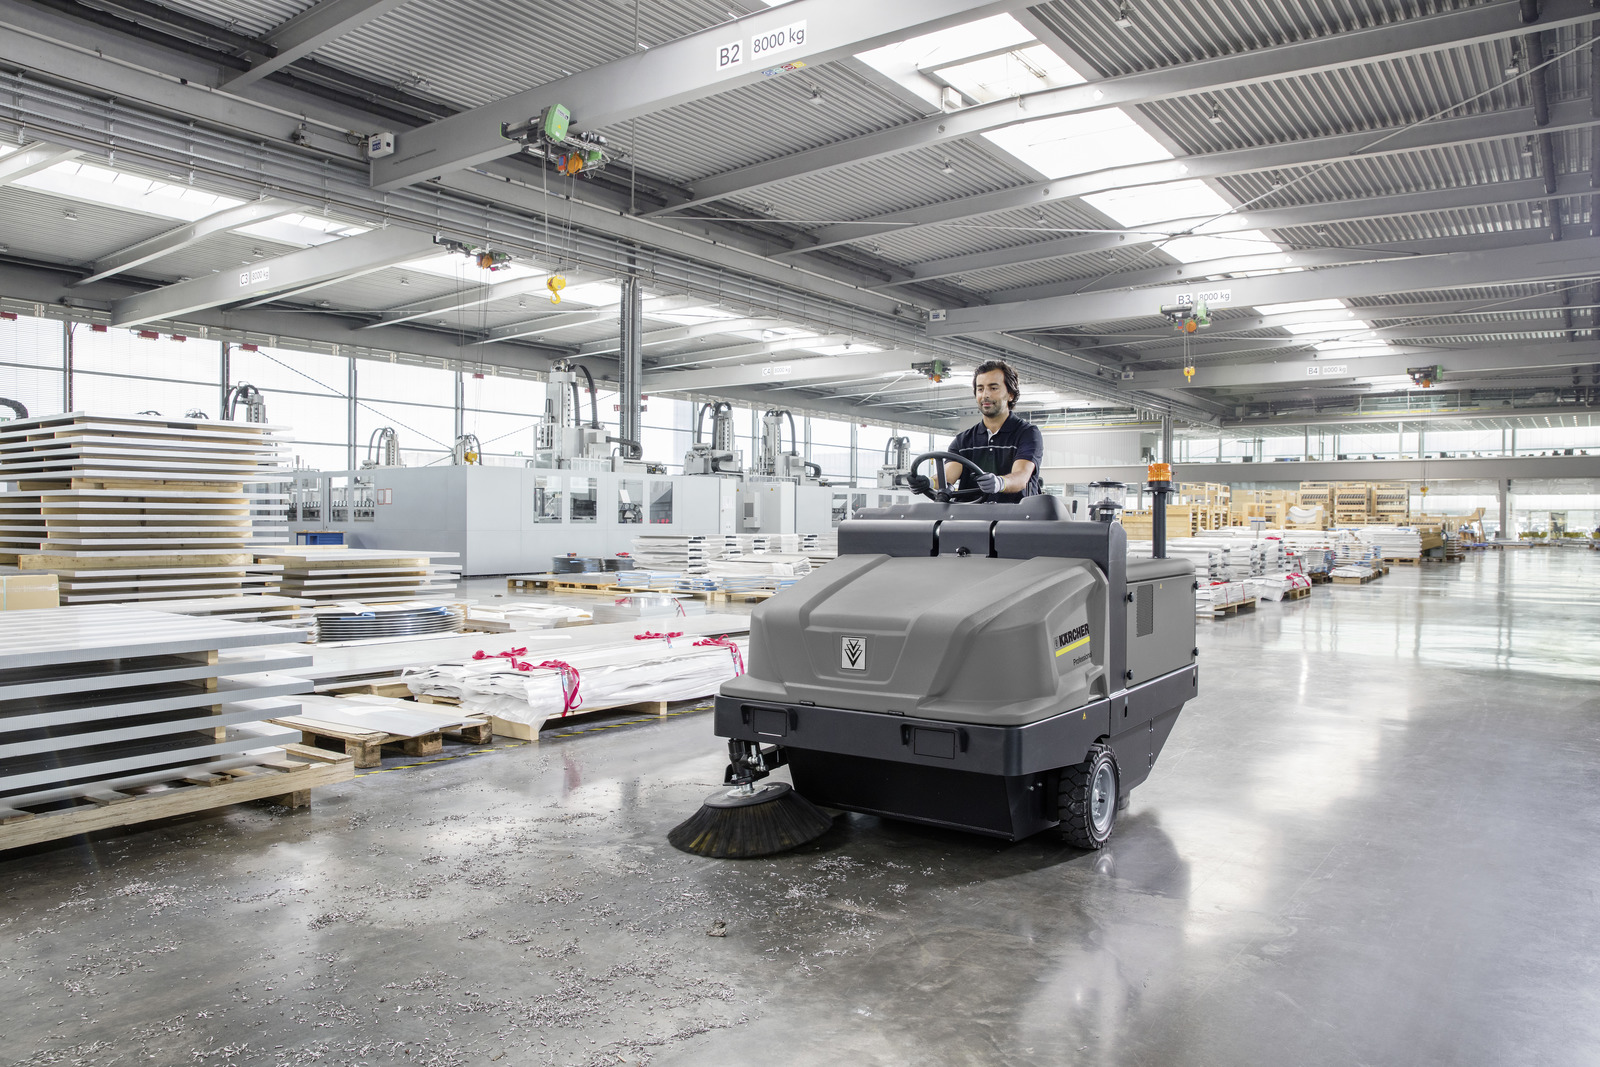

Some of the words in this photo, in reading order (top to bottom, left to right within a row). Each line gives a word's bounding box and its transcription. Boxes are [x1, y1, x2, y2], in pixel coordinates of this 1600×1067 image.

[720, 44, 740, 67] B2
[753, 31, 785, 54] 8000
[789, 27, 805, 45] kg
[241, 273, 249, 285] C3
[1178, 294, 1191, 305] B3
[1220, 291, 1230, 301] kg
[1308, 367, 1318, 375] B4
[1072, 651, 1093, 666] Professional
